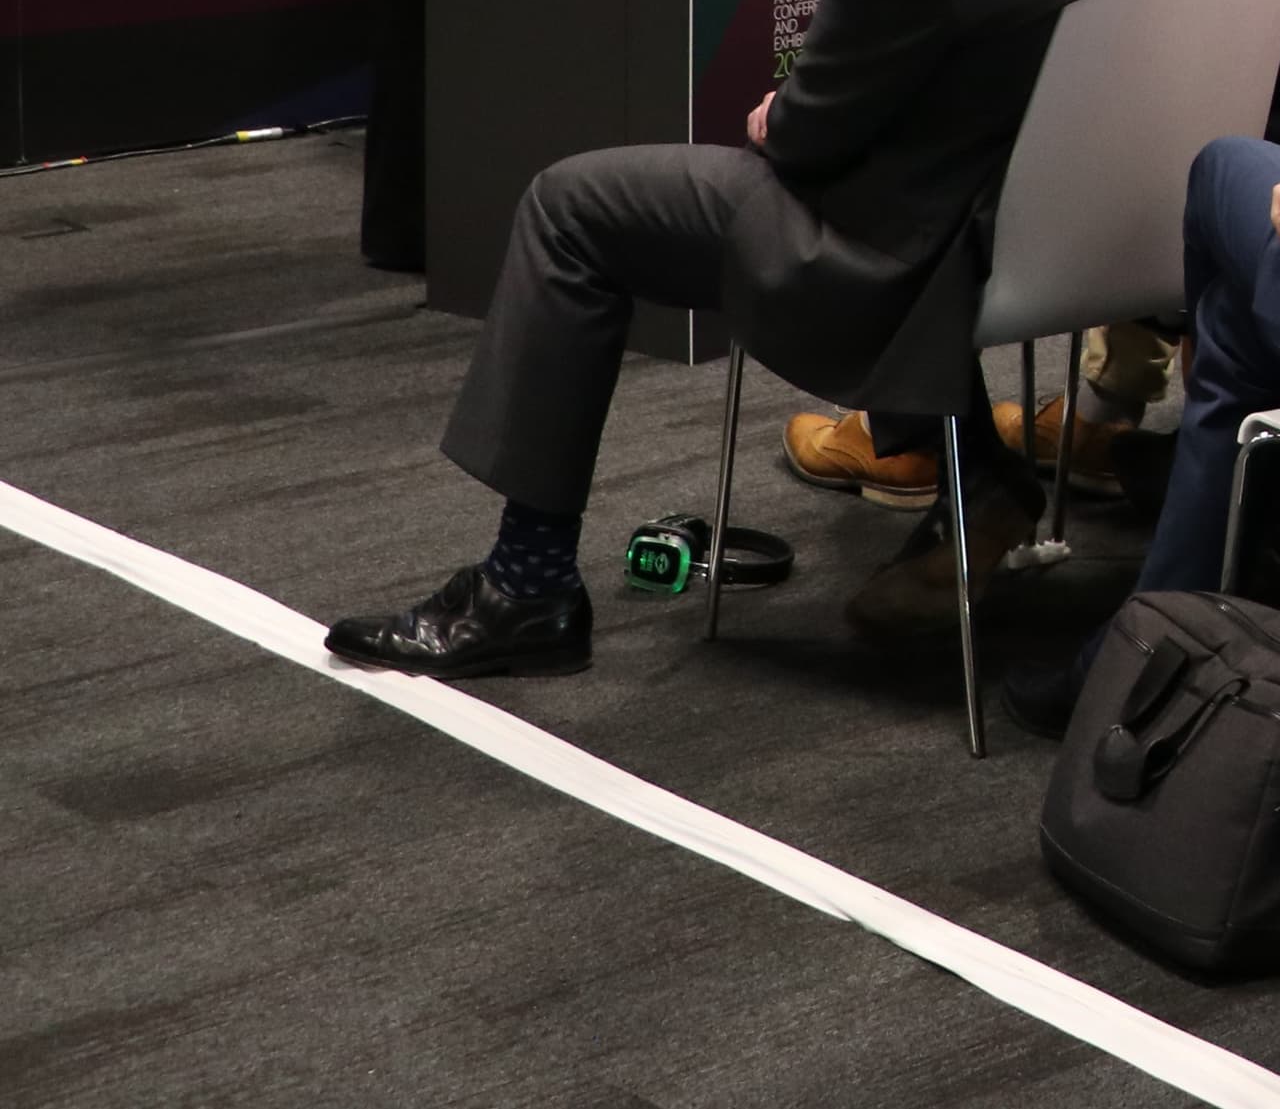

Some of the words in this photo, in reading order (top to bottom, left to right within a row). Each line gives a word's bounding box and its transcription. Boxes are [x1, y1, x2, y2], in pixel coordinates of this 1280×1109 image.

[774, 0, 821, 22] CONFER
[774, 18, 798, 36] AND
[773, 49, 804, 79] 20
